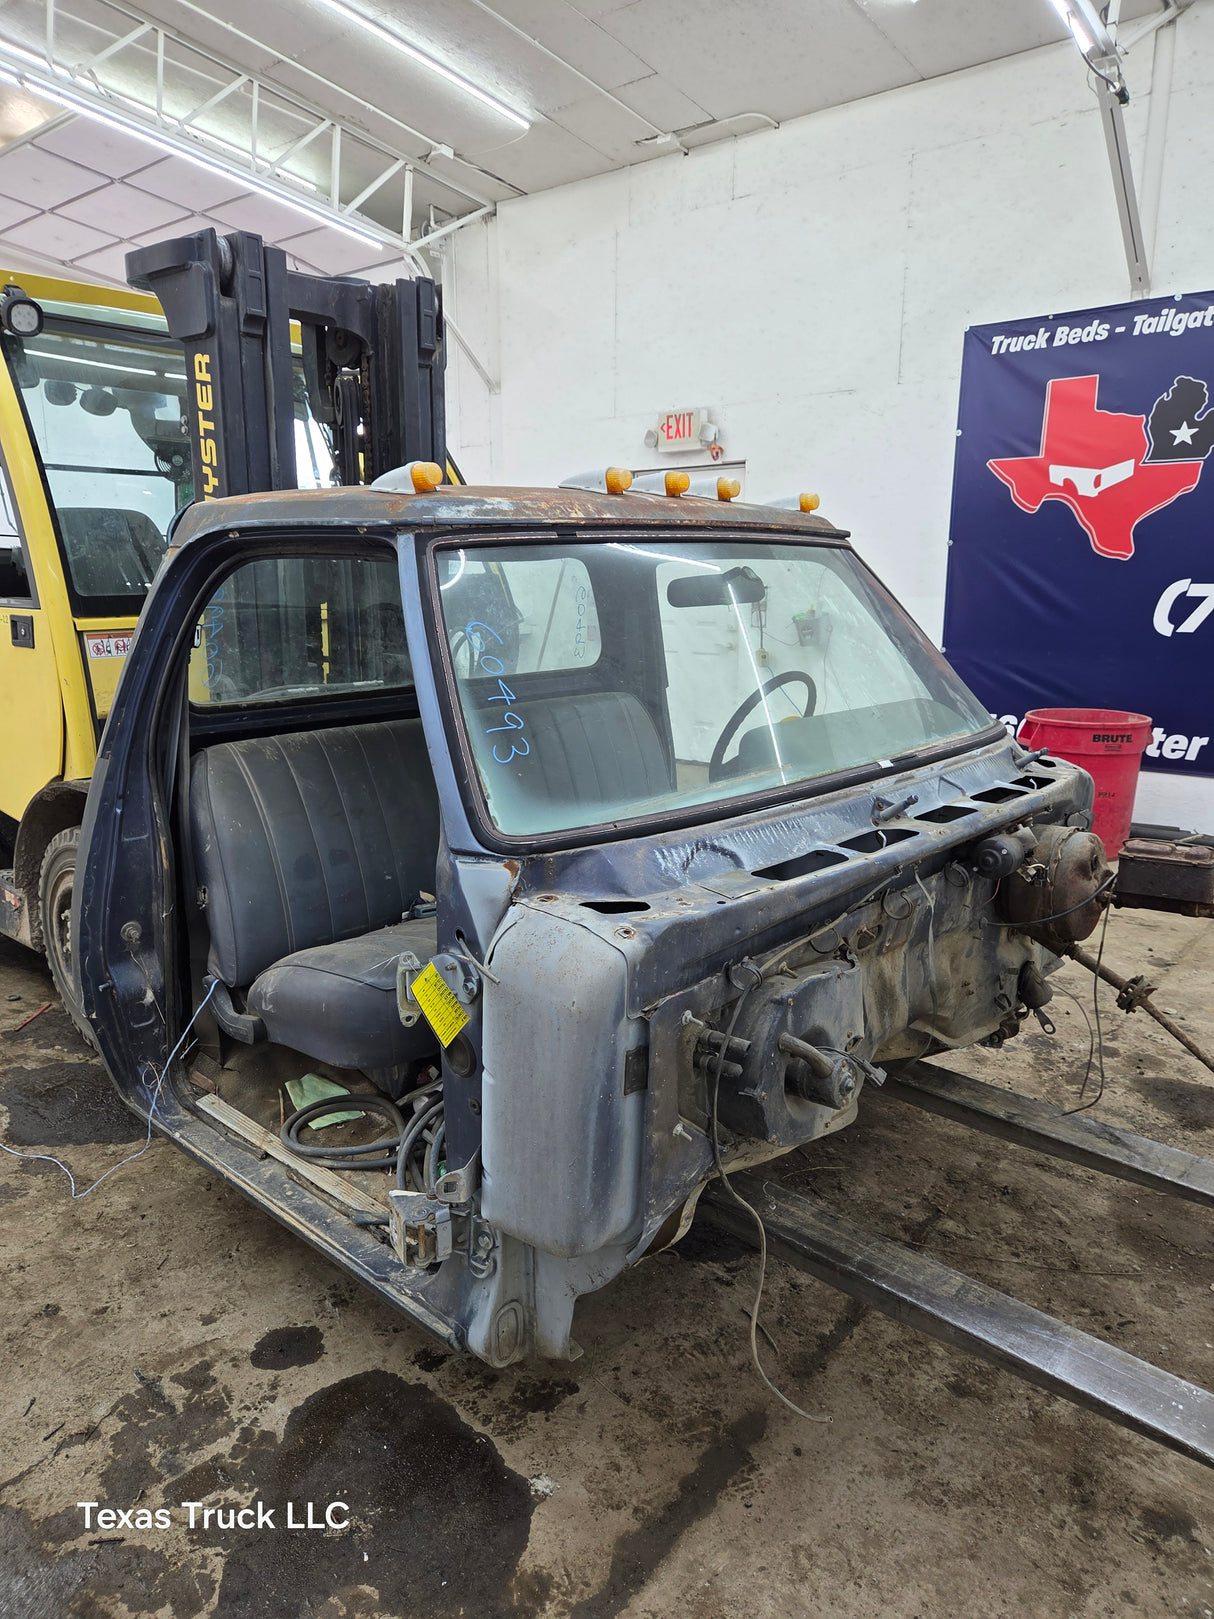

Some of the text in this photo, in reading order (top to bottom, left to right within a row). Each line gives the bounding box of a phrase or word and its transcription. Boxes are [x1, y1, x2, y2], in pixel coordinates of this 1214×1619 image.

[991, 328, 1050, 355] Truck
[1053, 320, 1110, 347] Beds
[666, 412, 694, 440] EXIT
[1153, 578, 1214, 637] (7
[465, 621, 530, 764] 60493
[1092, 734, 1133, 743] BRUTE
[1145, 727, 1210, 761] ter
